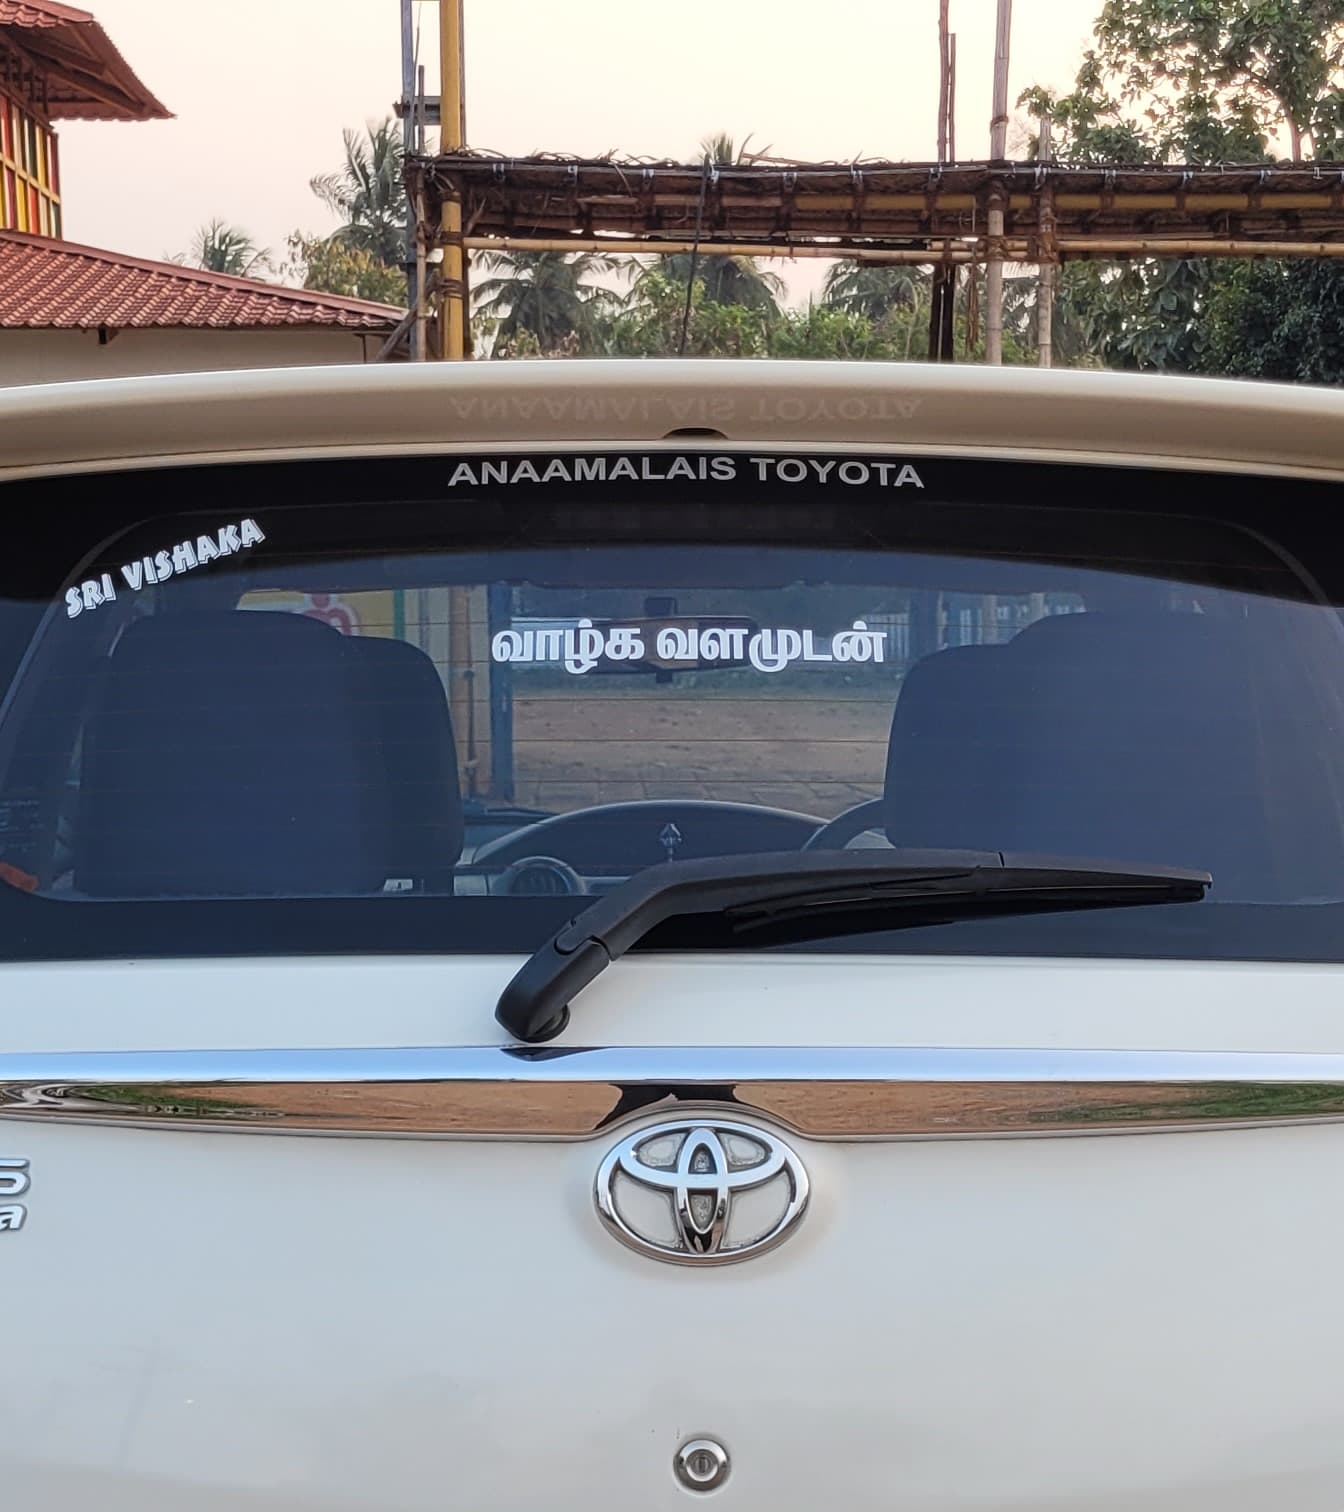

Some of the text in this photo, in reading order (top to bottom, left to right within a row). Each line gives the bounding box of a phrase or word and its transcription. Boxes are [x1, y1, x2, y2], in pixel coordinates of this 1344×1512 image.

[447, 456, 925, 488] ANAAMALAIS TOYOTA
[65, 519, 266, 618] SRI VISHAKA
[491, 618, 887, 674] வாழ்க வளமுடன்
